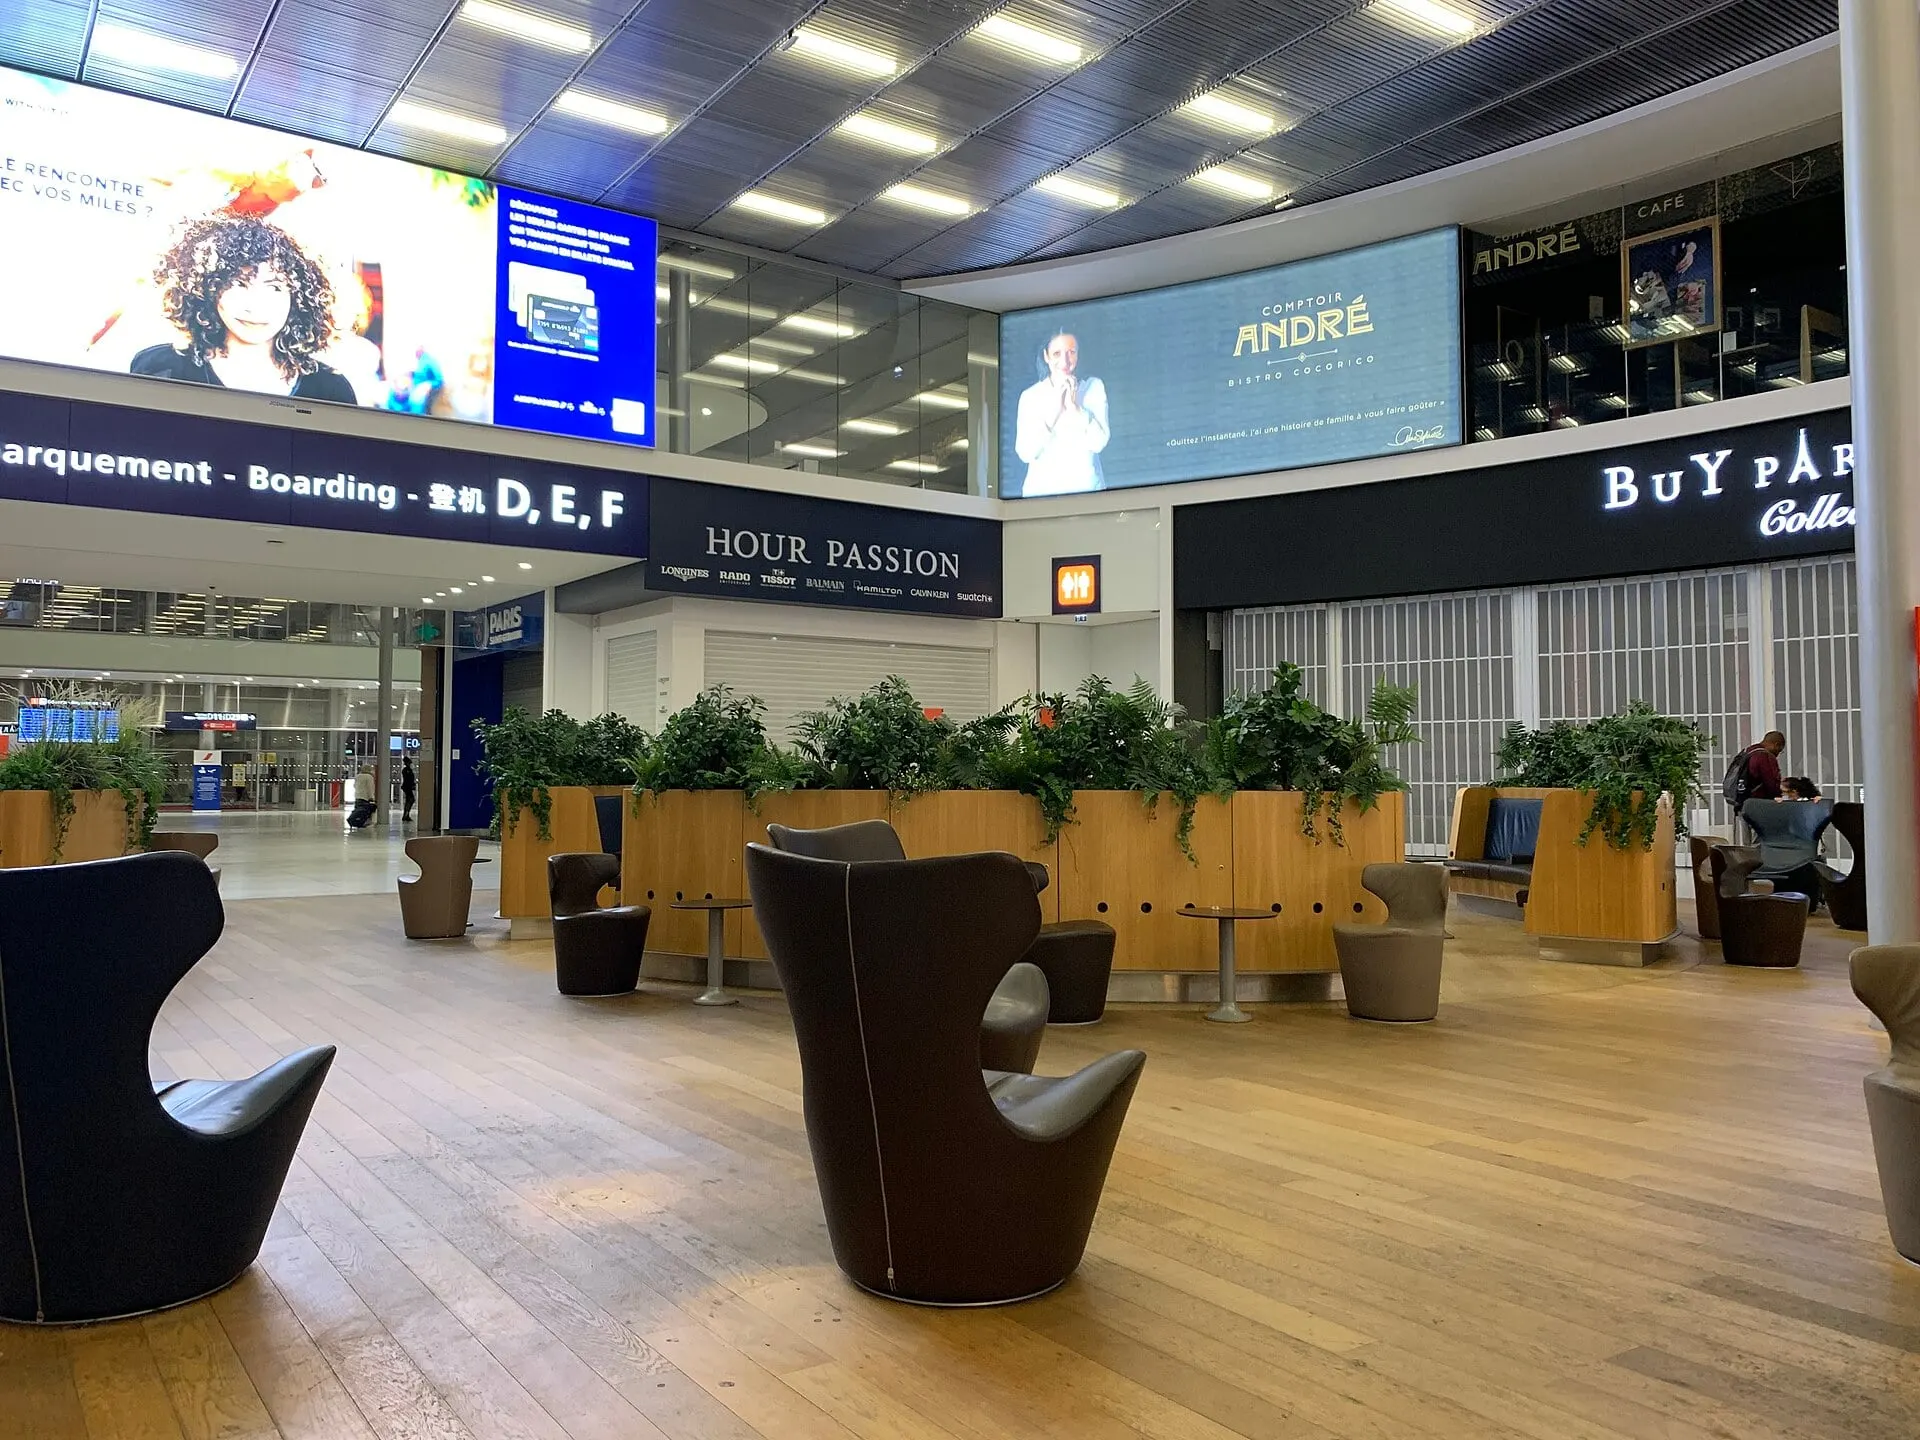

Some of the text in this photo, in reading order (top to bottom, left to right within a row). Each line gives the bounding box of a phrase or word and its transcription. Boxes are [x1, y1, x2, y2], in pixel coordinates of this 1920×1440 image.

[25, 162, 145, 197] RENCONTRE
[33, 183, 71, 202] VOS
[80, 193, 137, 215] MILES
[1637, 192, 1685, 218] CAFÉ
[1472, 222, 1581, 276] ANDRÉ
[1262, 292, 1343, 316] COMPTOIR
[1233, 294, 1374, 357] ANDRÉ
[1228, 355, 1374, 388] BISTRO COCORICO
[1264, 426, 1279, 434] une
[1281, 420, 1311, 432] histoire
[1314, 418, 1324, 427] de
[1326, 415, 1354, 426] famille
[1364, 410, 1384, 419] vous
[1386, 403, 1406, 415] faire
[1408, 399, 1437, 413] goûter
[1, 442, 213, 485] arquement
[249, 464, 397, 510] Boarding
[428, 482, 486, 514] 登机
[706, 526, 960, 579] HOUR PASSION
[661, 565, 710, 578] LONGINES
[719, 571, 751, 582] RADO
[760, 575, 797, 586] TISSOT
[806, 577, 845, 590] BALMAIN
[910, 588, 950, 599] CALVIN KLEIN
[490, 605, 522, 634] PARIS
[405, 738, 420, 748] E0
